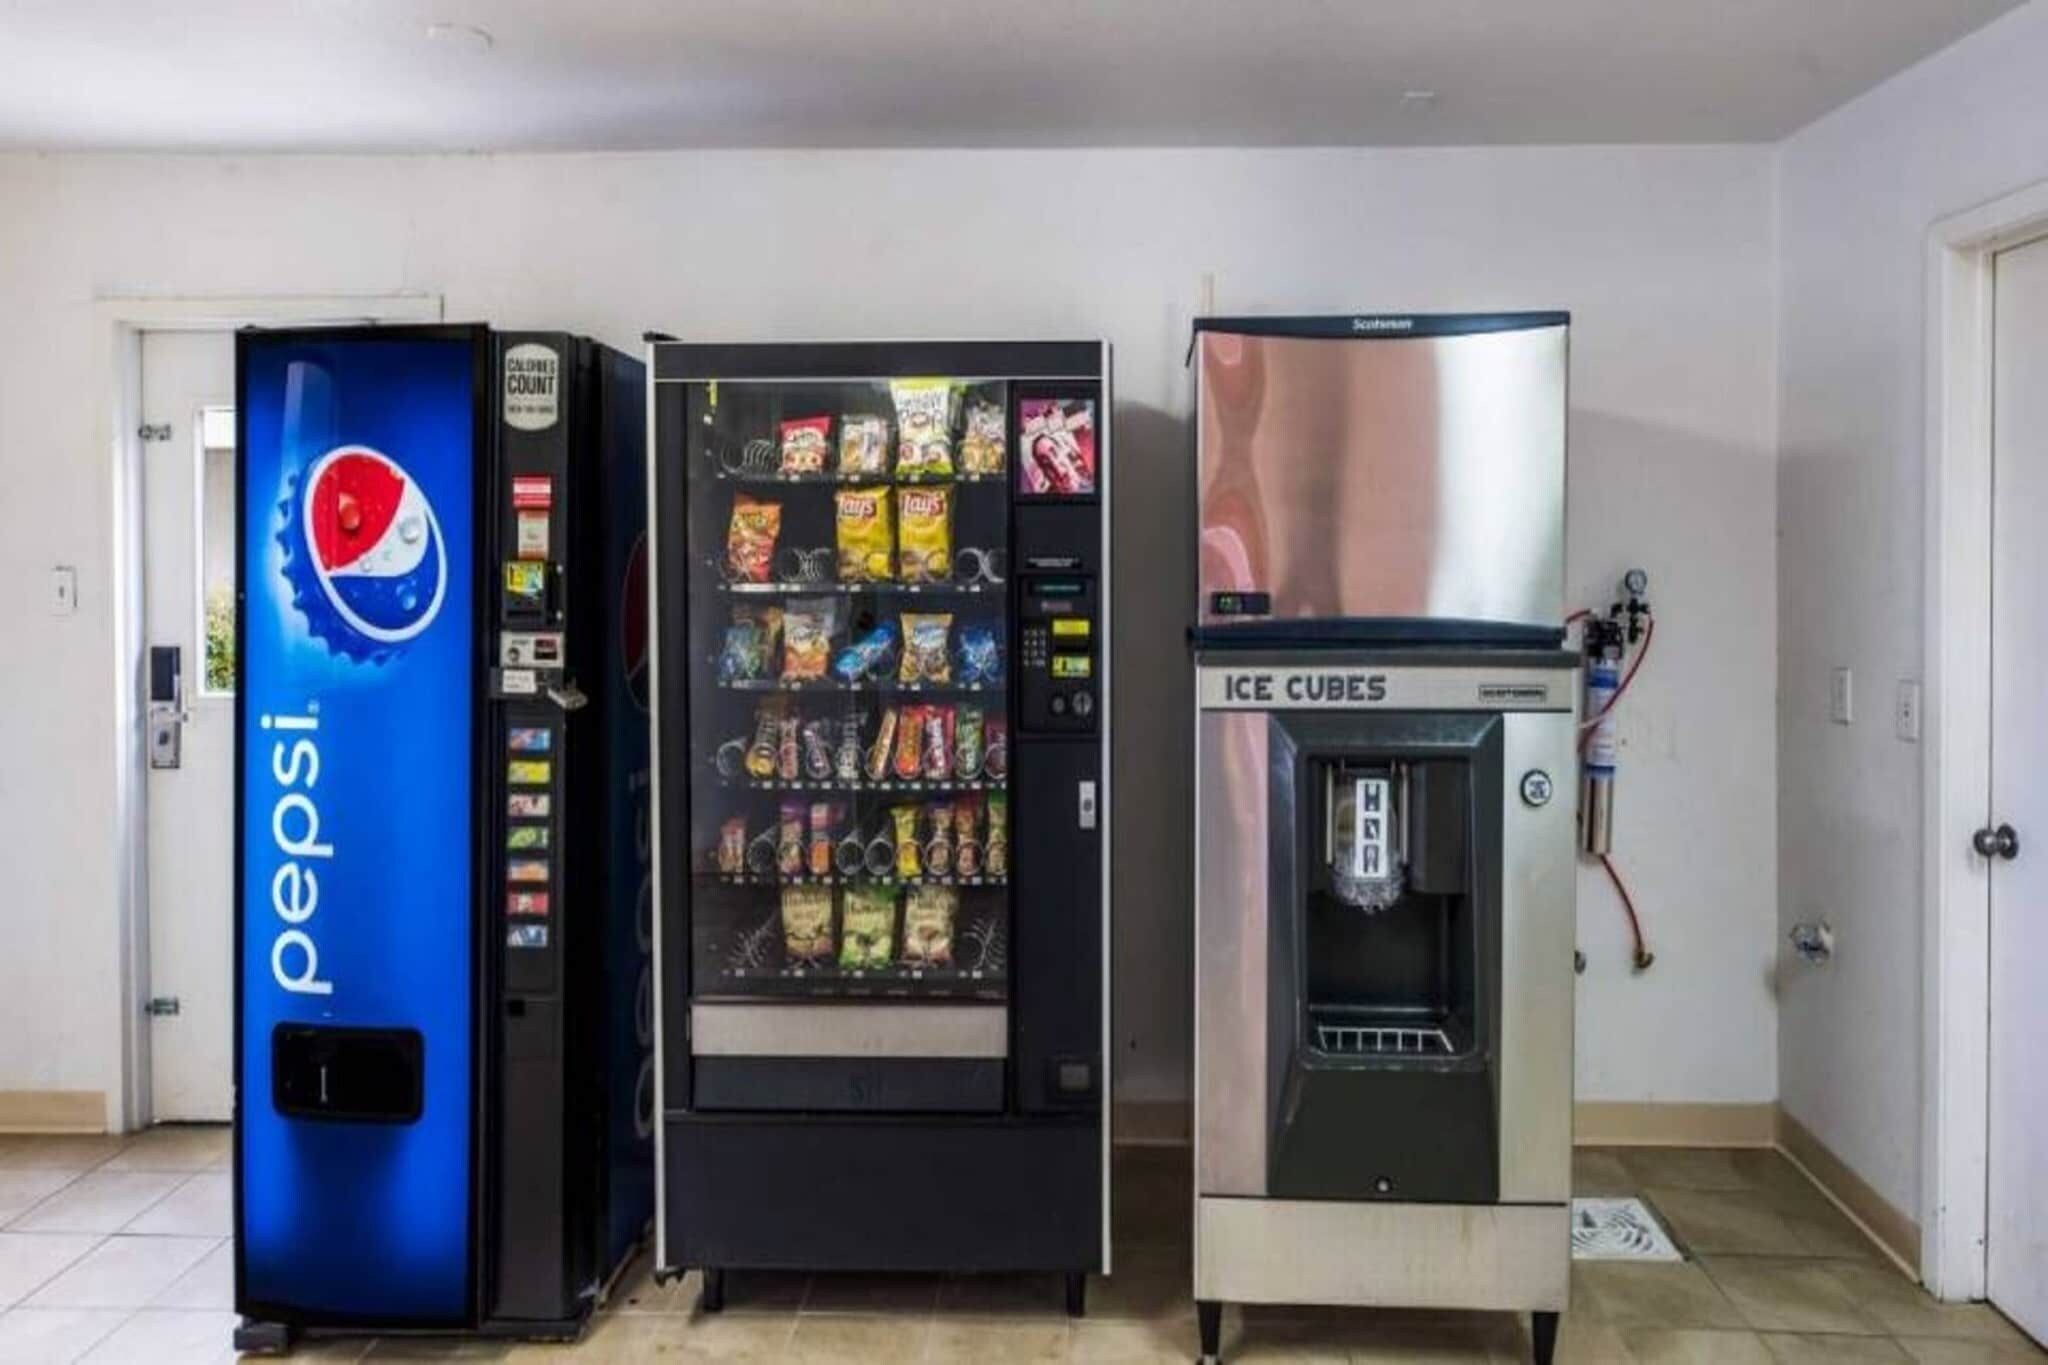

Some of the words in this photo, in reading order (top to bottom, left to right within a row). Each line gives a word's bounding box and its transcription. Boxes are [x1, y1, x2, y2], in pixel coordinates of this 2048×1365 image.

[507, 373, 555, 395] COUNT
[1225, 674, 1273, 701] ICE
[1285, 674, 1387, 701] CUBES
[260, 712, 335, 996] pepsi
